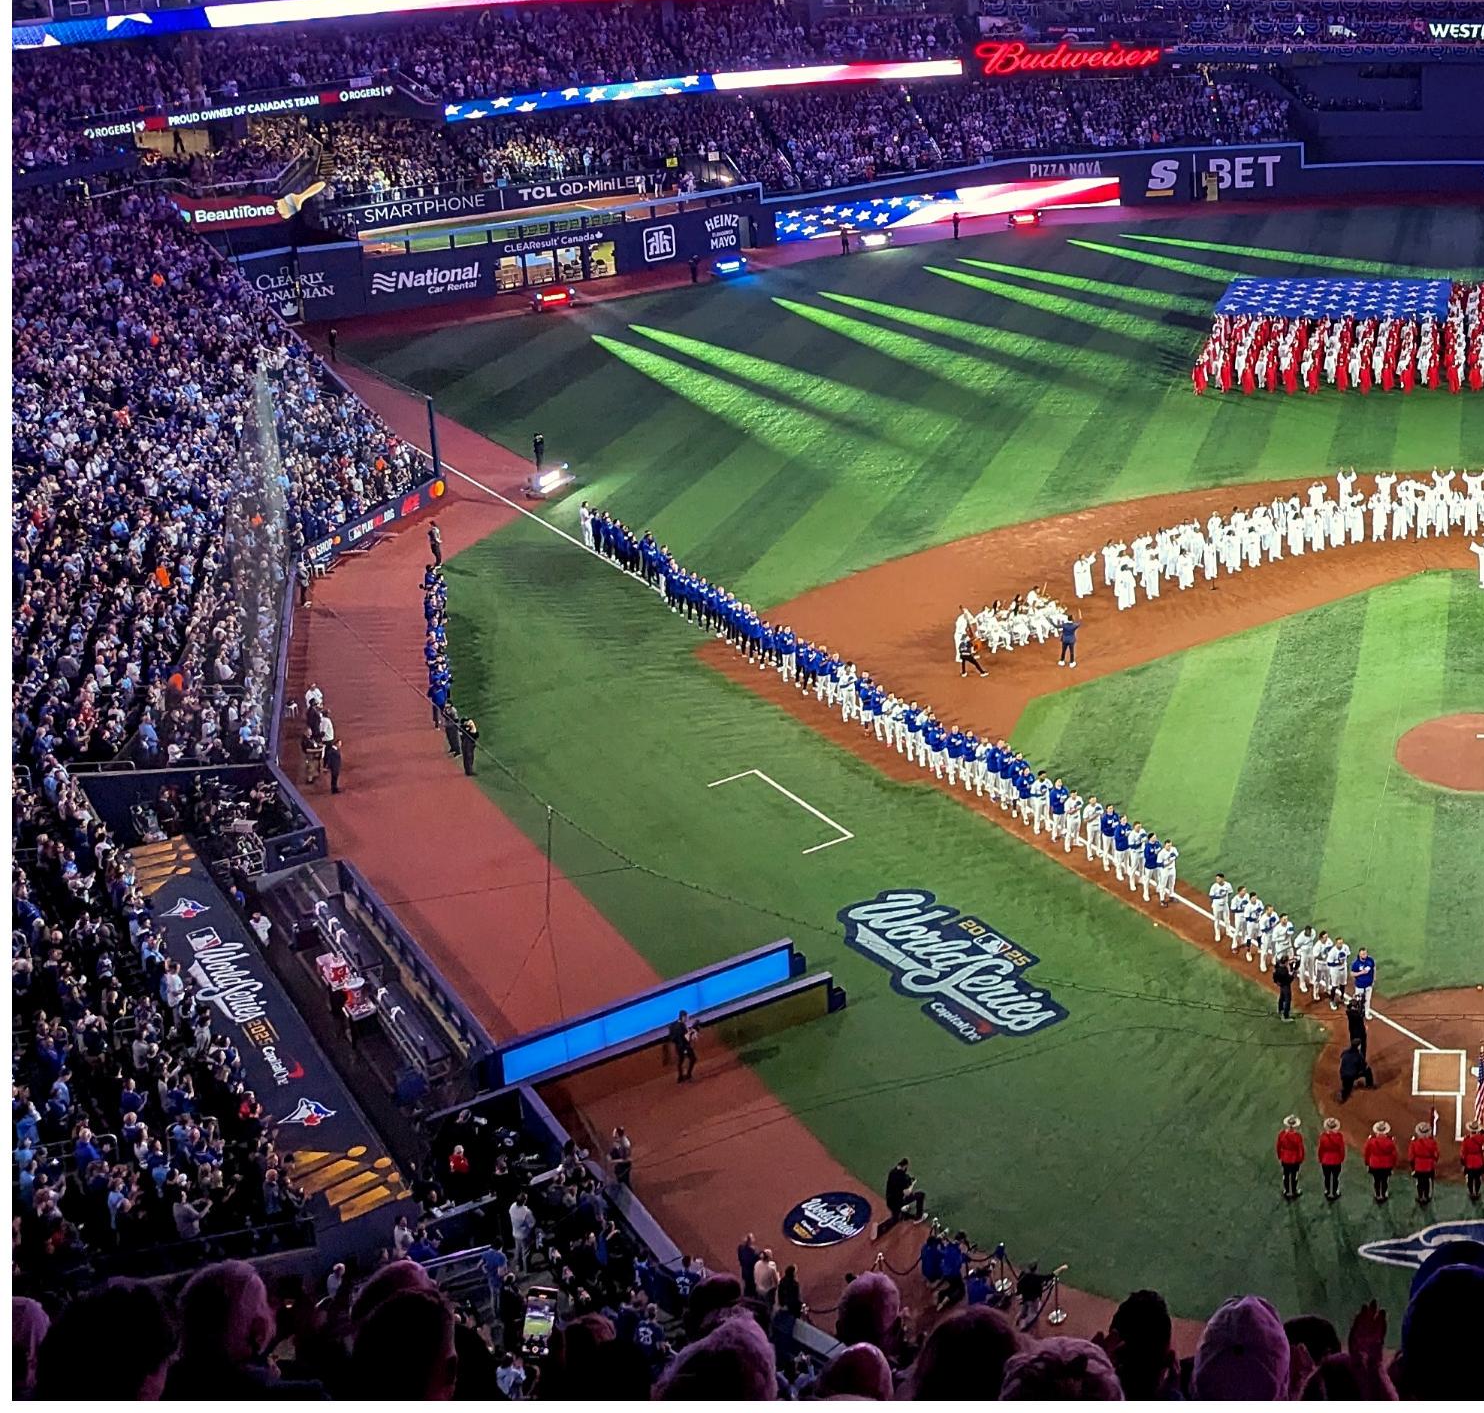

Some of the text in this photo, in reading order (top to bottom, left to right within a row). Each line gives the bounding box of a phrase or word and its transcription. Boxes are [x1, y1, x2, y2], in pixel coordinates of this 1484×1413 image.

[975, 41, 1161, 75] Budweiser
[349, 86, 381, 100] ROGERS
[168, 94, 320, 126] PROUD OWNER OF CANADA'S TEAM
[95, 122, 132, 138] ROGERS
[1029, 160, 1101, 178] PIZZA NOVA
[1204, 155, 1282, 190] BET
[518, 186, 557, 202] TCL
[559, 178, 616, 196] QD-Mini
[195, 204, 276, 223] BeautiTone
[363, 193, 486, 224] SMARTPHONE
[704, 213, 740, 232] HEINZ
[504, 232, 595, 254] CLEAResult Canada
[709, 234, 737, 250] MAYO
[398, 261, 480, 291] National
[428, 280, 478, 295] Car Rental
[316, 538, 333, 557] SHOP
[958, 918, 985, 937] 20
[194, 941, 251, 992] World
[847, 892, 1057, 1031] World Series
[1003, 949, 1032, 967] 25
[245, 1018, 276, 1048] 2025
